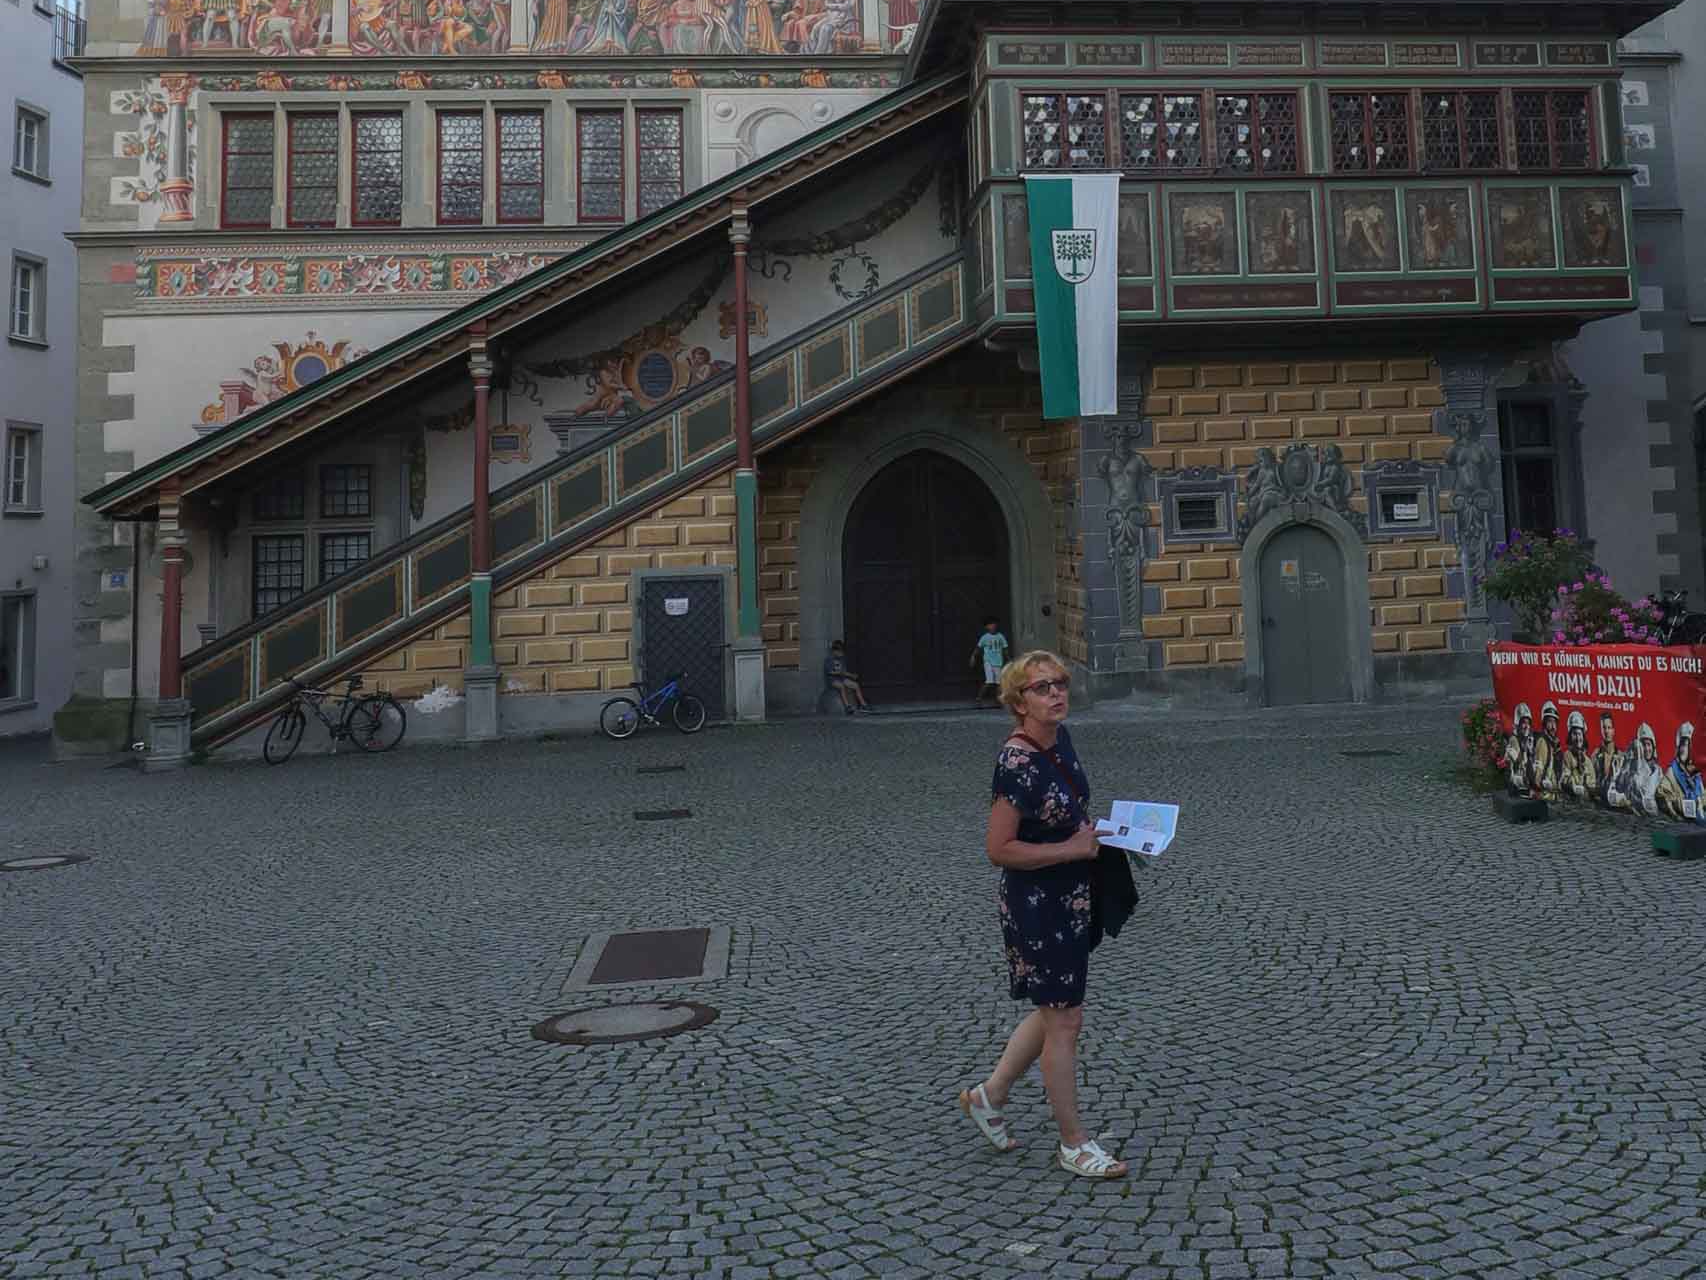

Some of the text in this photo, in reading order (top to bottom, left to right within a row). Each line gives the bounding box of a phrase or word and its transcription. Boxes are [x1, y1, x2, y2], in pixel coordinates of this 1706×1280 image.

[1491, 650, 1703, 674] WENN WIR ES KÖNNEN, KANNST DU ES AUCH!
[1548, 671, 1642, 699] KOMM DAZU!
